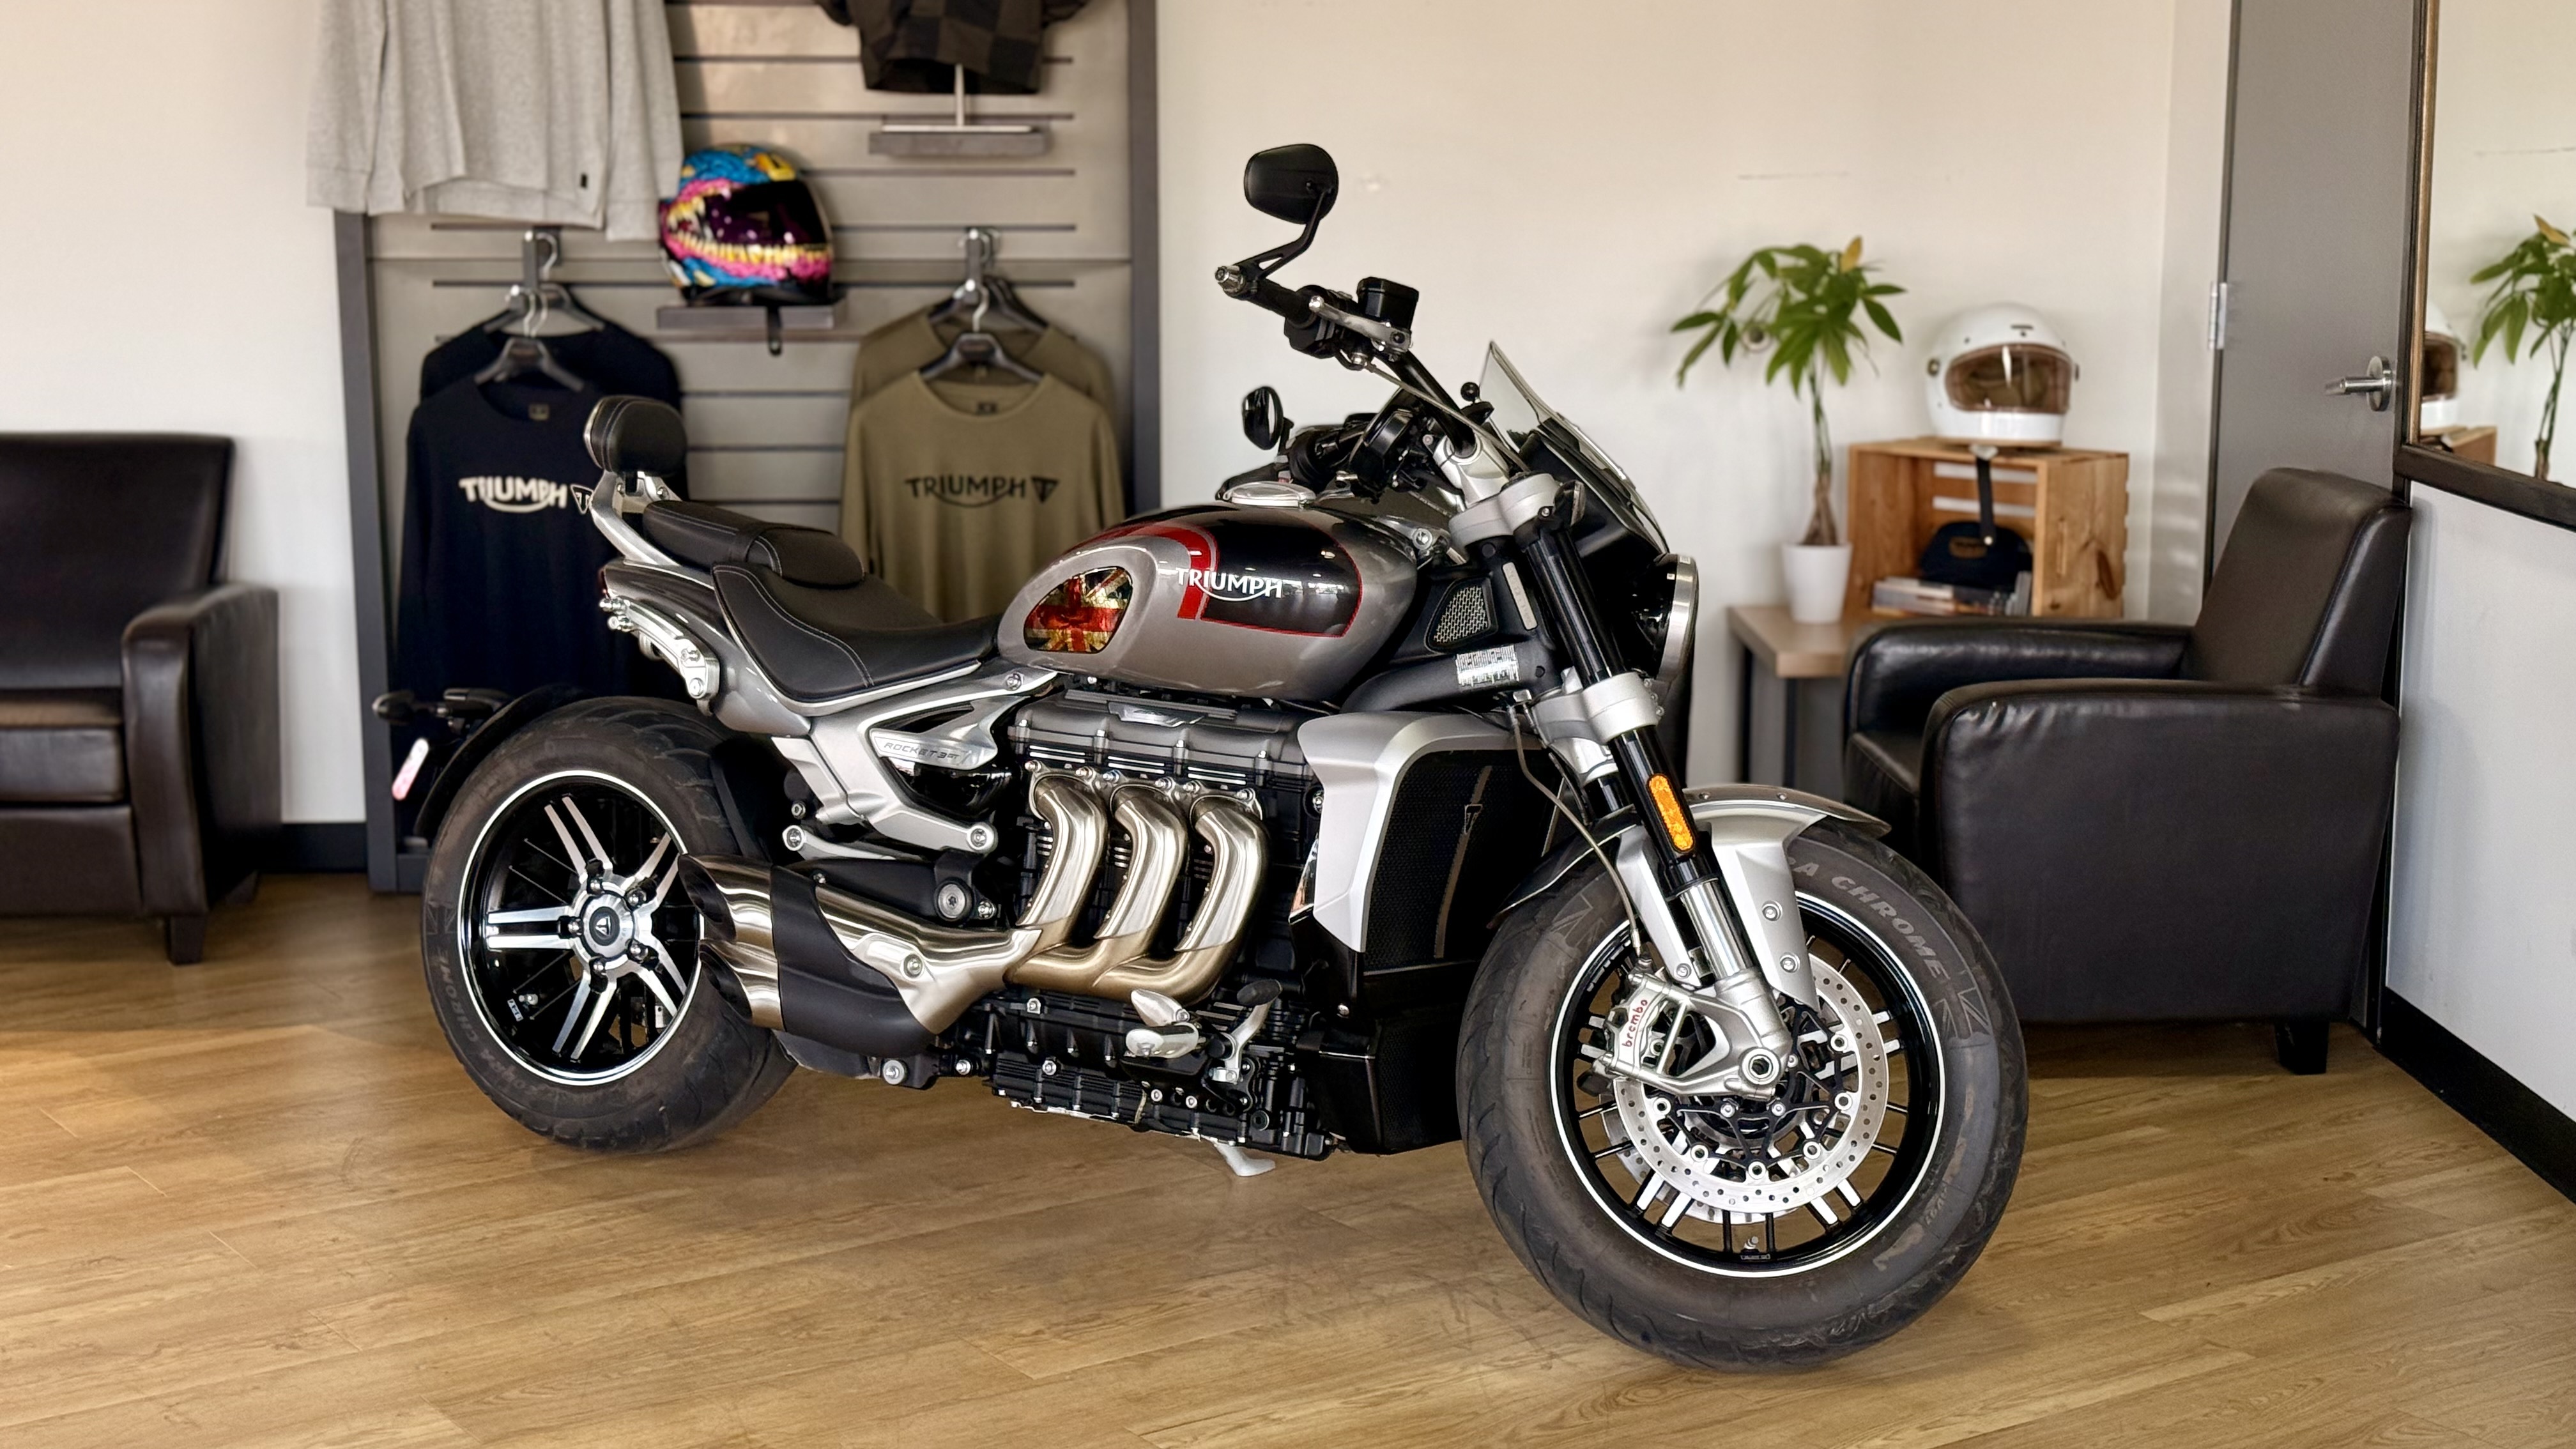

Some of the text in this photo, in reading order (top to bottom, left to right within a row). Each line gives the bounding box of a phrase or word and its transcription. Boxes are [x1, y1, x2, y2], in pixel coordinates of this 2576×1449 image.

[905, 475, 1026, 507] TRIUMPH
[1176, 567, 1283, 601] TRIUMPH
[1831, 876, 1951, 981] CHROME
[1623, 999, 1648, 1048] brembo
